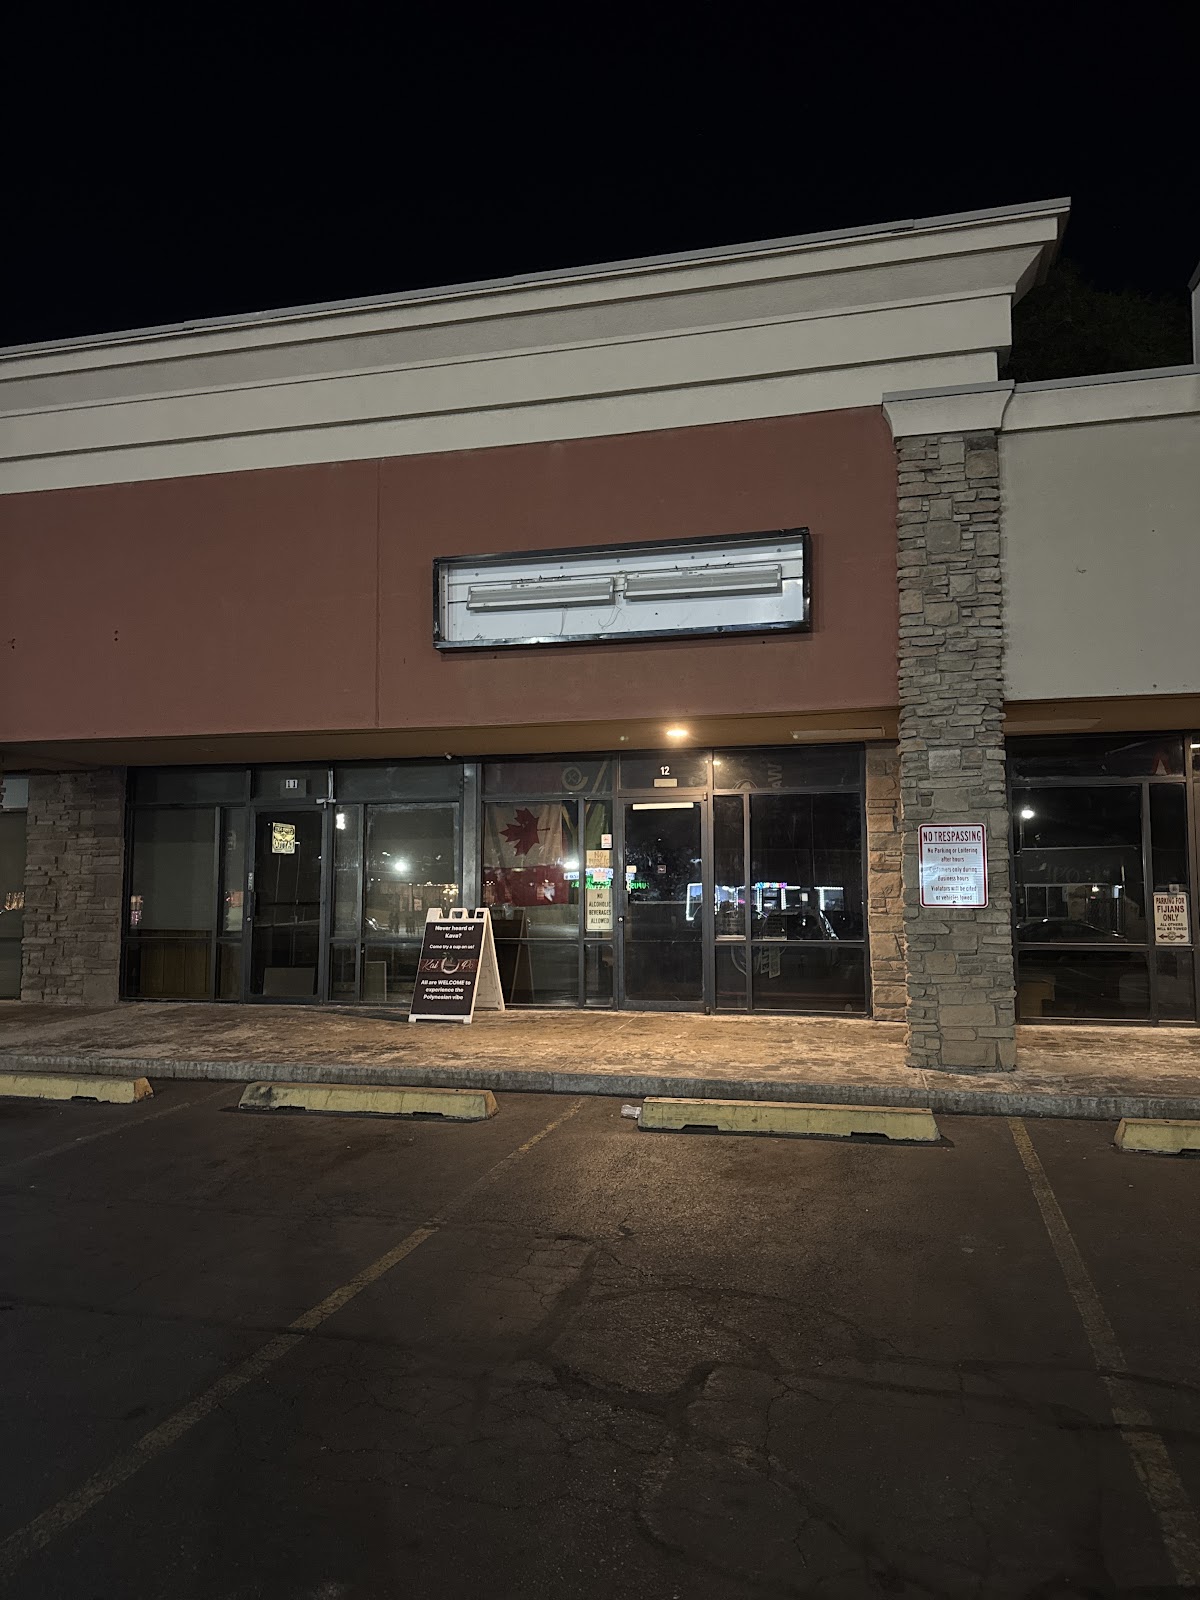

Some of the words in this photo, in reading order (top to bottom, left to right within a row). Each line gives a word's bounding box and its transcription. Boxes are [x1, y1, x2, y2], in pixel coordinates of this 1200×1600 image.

[660, 766, 670, 776] 12
[287, 780, 296, 788] 11
[923, 831, 932, 842] NO
[934, 830, 982, 842] TRESPASSING
